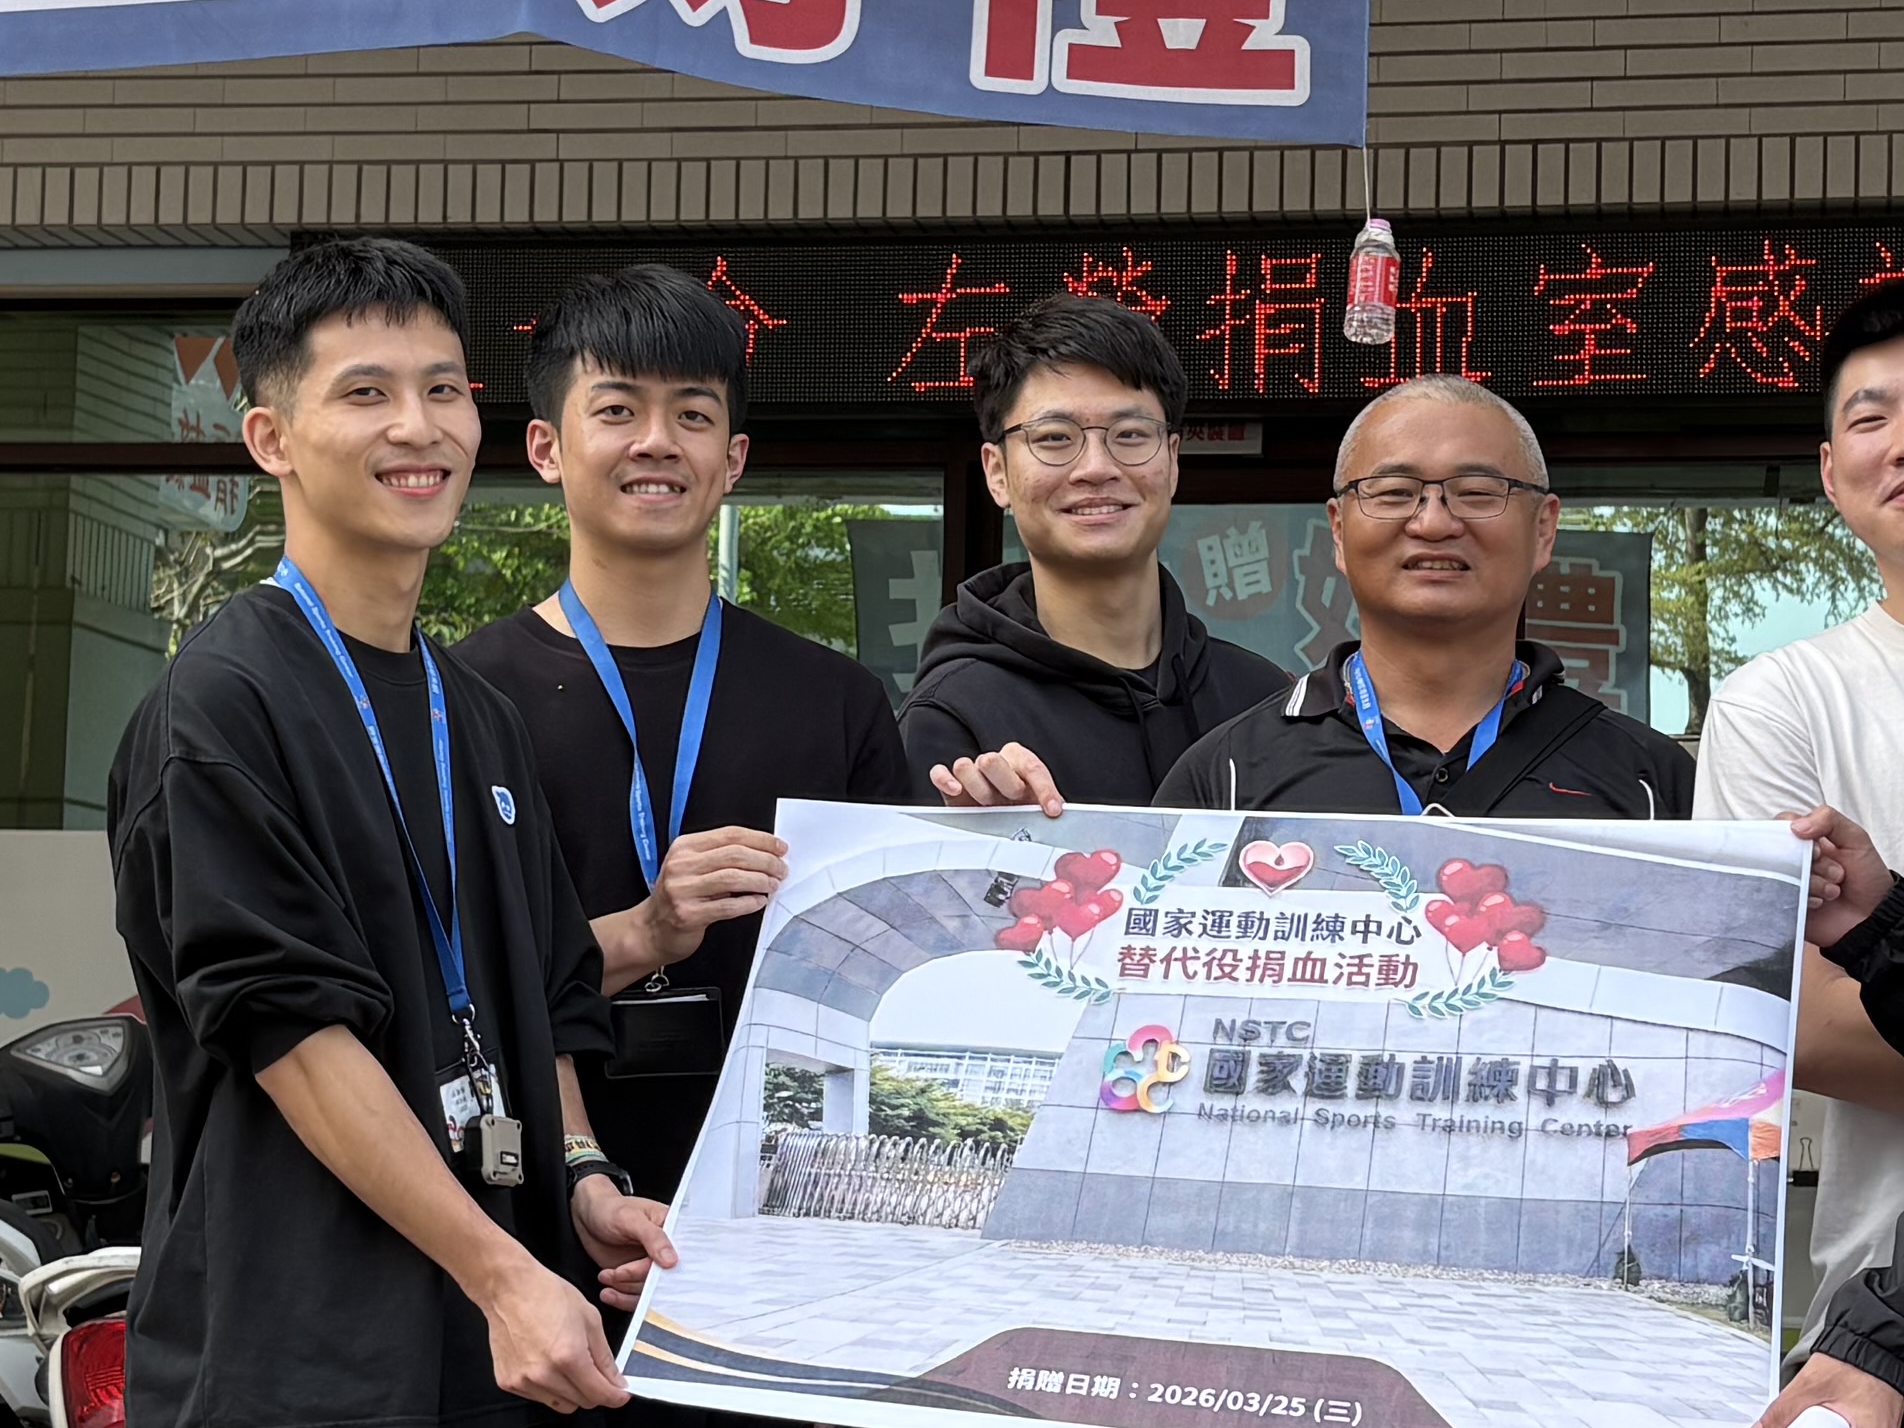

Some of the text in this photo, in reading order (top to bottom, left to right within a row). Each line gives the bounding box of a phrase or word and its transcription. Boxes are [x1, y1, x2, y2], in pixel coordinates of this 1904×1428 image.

[1123, 906, 1423, 946] 國家運動訓練中心
[1116, 945, 1419, 990] 替代役捐血活動
[1213, 1018, 1311, 1045] NSTC
[1204, 1047, 1636, 1107] 國家運動訓練中心
[1197, 1102, 1299, 1125] National
[1313, 1107, 1396, 1132] Sports
[1416, 1112, 1524, 1139] Training
